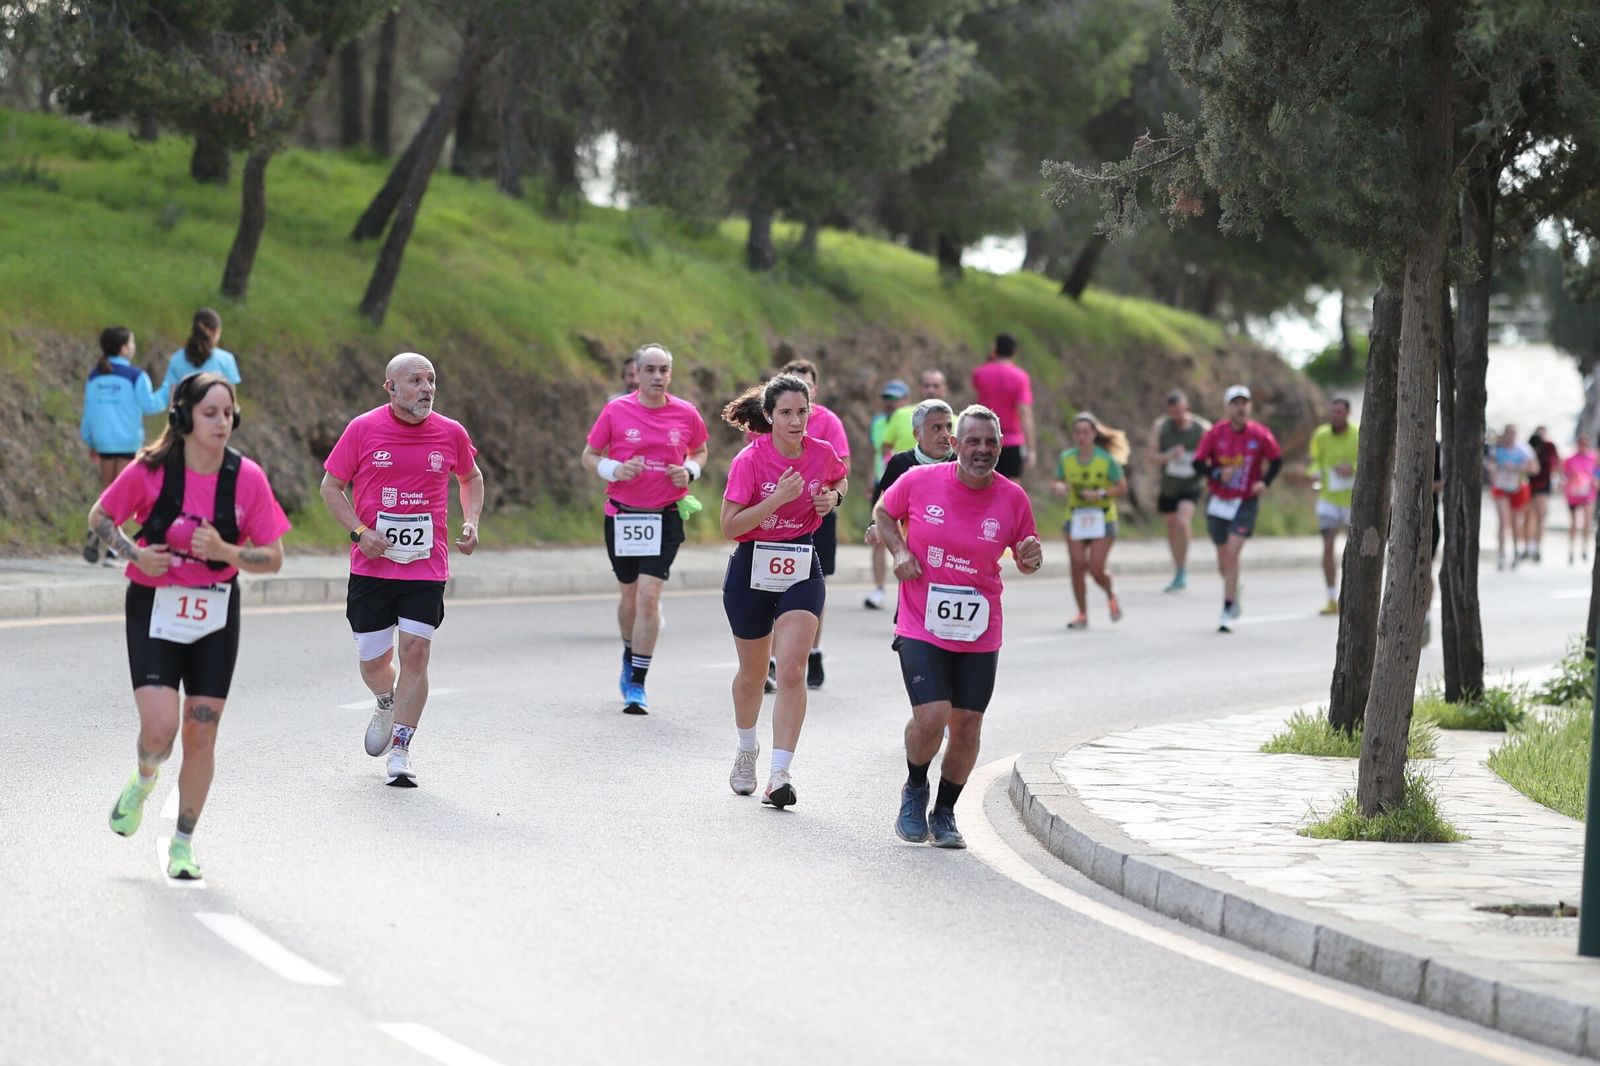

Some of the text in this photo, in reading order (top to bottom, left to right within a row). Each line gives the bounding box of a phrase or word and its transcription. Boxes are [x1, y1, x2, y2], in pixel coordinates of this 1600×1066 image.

[385, 527, 425, 546] 662
[623, 525, 654, 541] 550
[769, 556, 796, 575] 68
[946, 554, 971, 566] Ciudad
[176, 596, 208, 621] 15
[937, 599, 981, 622] 617
